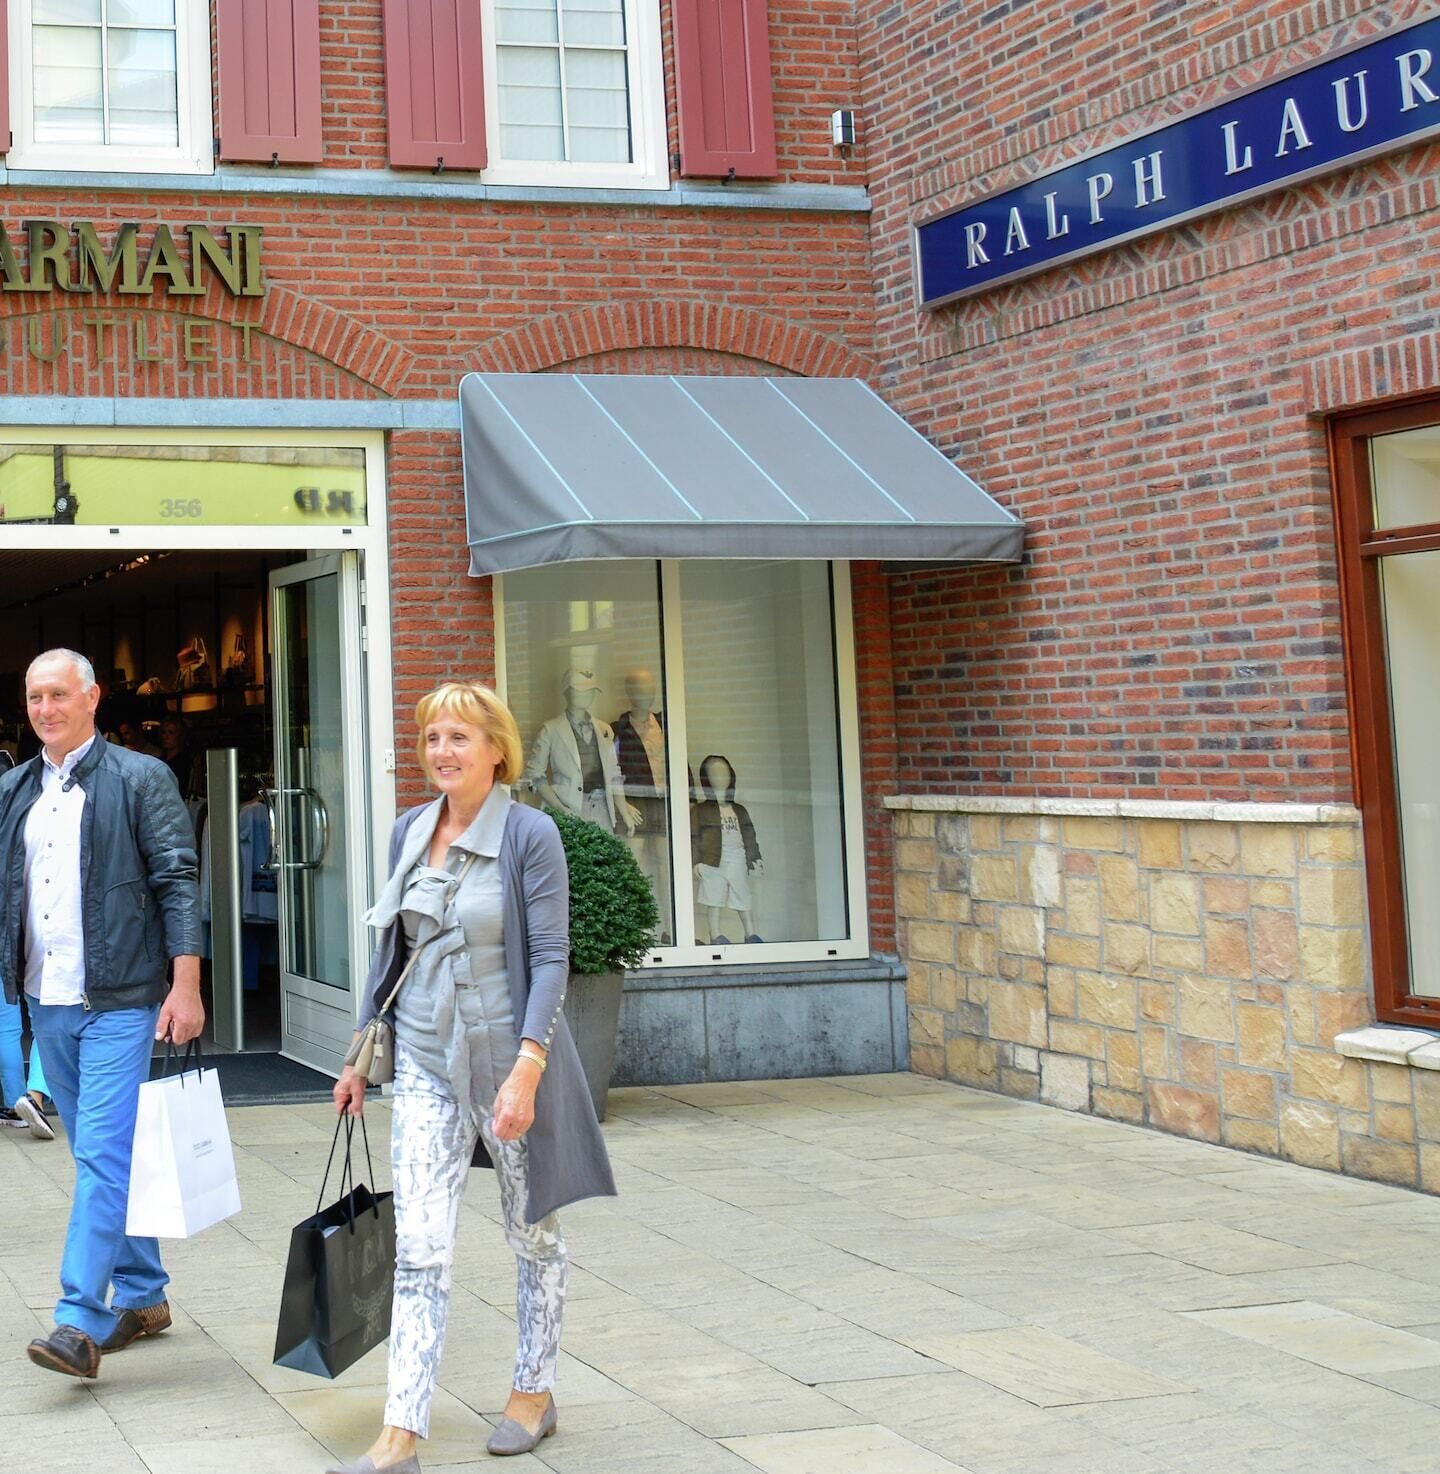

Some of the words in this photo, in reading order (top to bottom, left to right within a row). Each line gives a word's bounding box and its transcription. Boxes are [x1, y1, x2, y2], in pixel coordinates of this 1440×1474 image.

[964, 149, 1167, 271] RALPH
[1220, 47, 1440, 177] LAUR
[159, 497, 203, 519] 356
